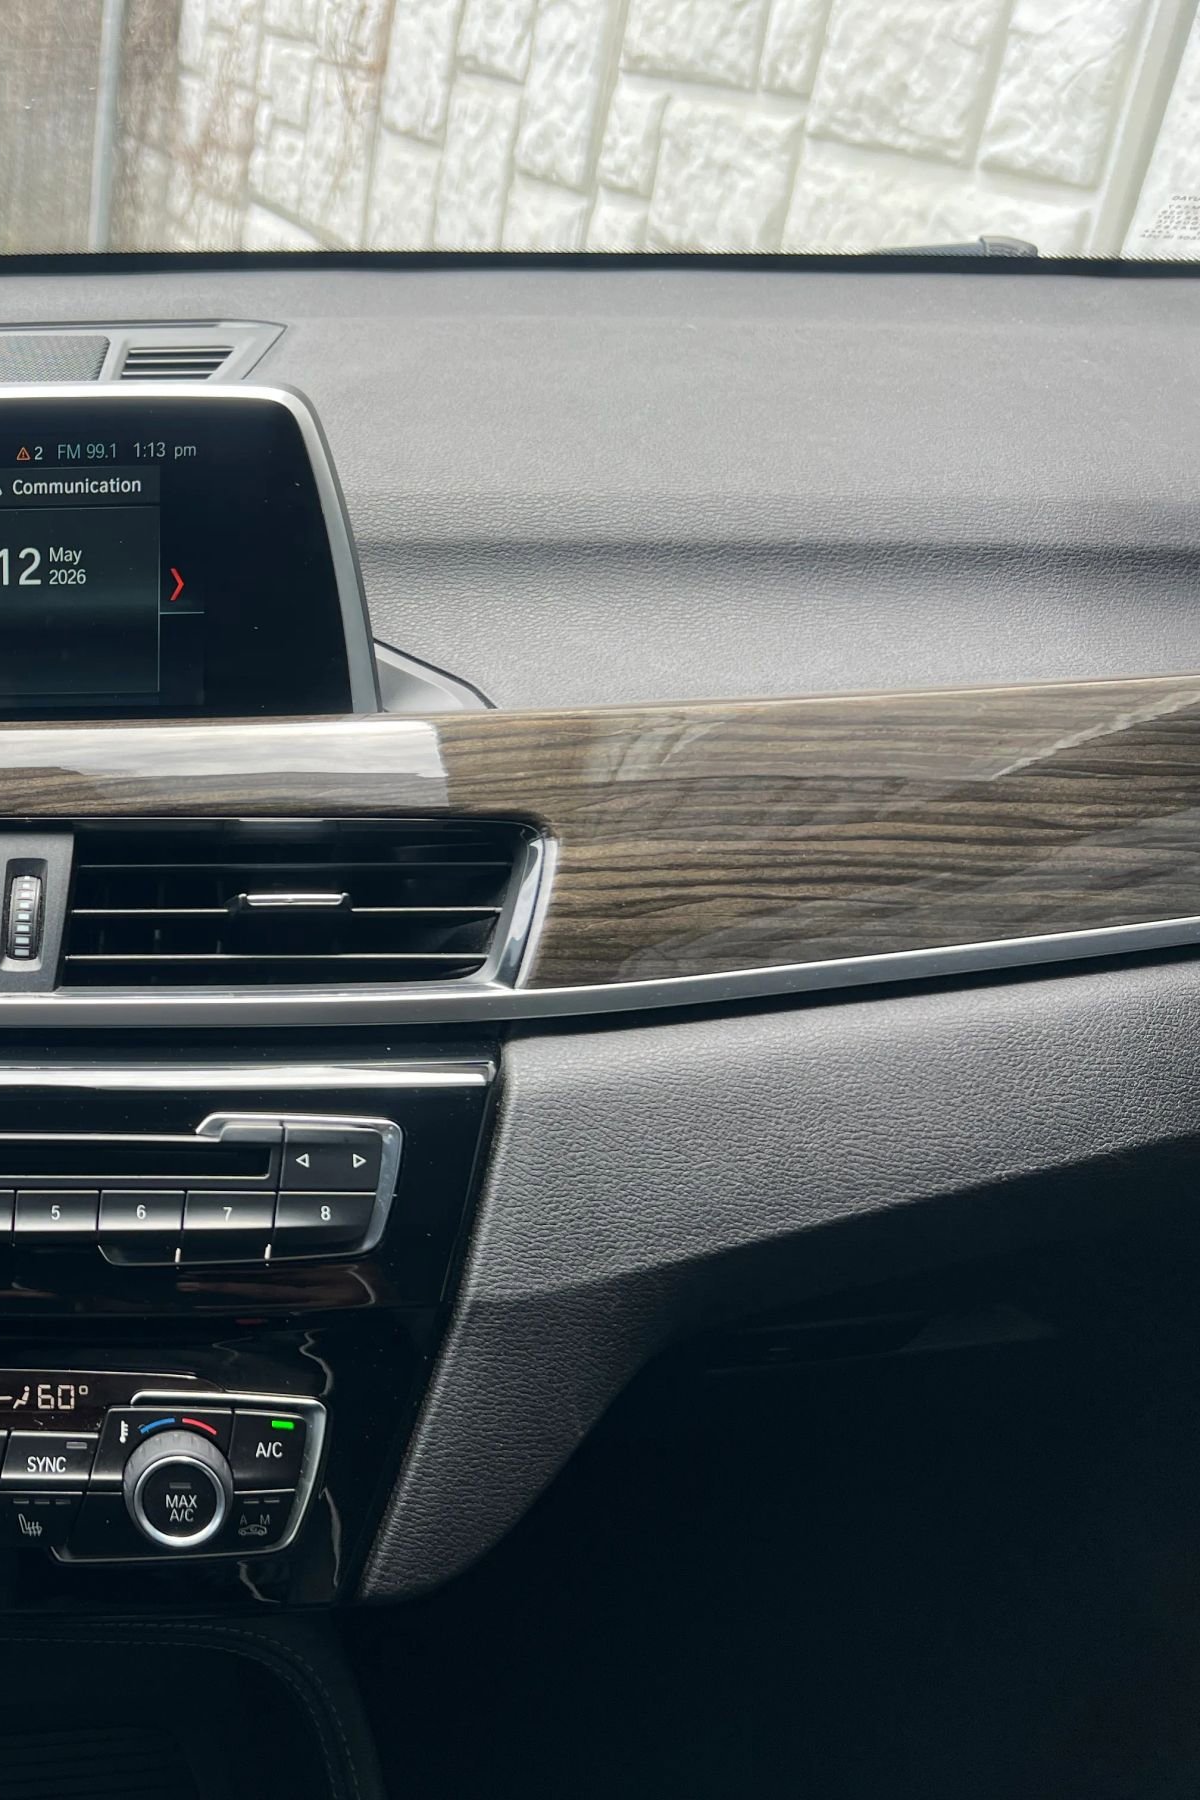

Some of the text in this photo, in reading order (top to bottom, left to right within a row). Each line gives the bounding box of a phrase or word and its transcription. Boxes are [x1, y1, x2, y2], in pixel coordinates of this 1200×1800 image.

[34, 442, 197, 460] 2 FM 99.1 1:13 pm
[12, 477, 142, 495] Communication
[49, 547, 82, 565] May
[49, 569, 87, 585] 2026
[51, 1205, 60, 1220] 5
[136, 1205, 146, 1220] 6
[223, 1206, 232, 1221] 7
[320, 1206, 331, 1221] 8
[255, 1441, 283, 1458] A/C
[27, 1457, 67, 1473] SYNC
[165, 1494, 197, 1509] MAX
[170, 1509, 194, 1522] A/C
[240, 1514, 270, 1525] A M
